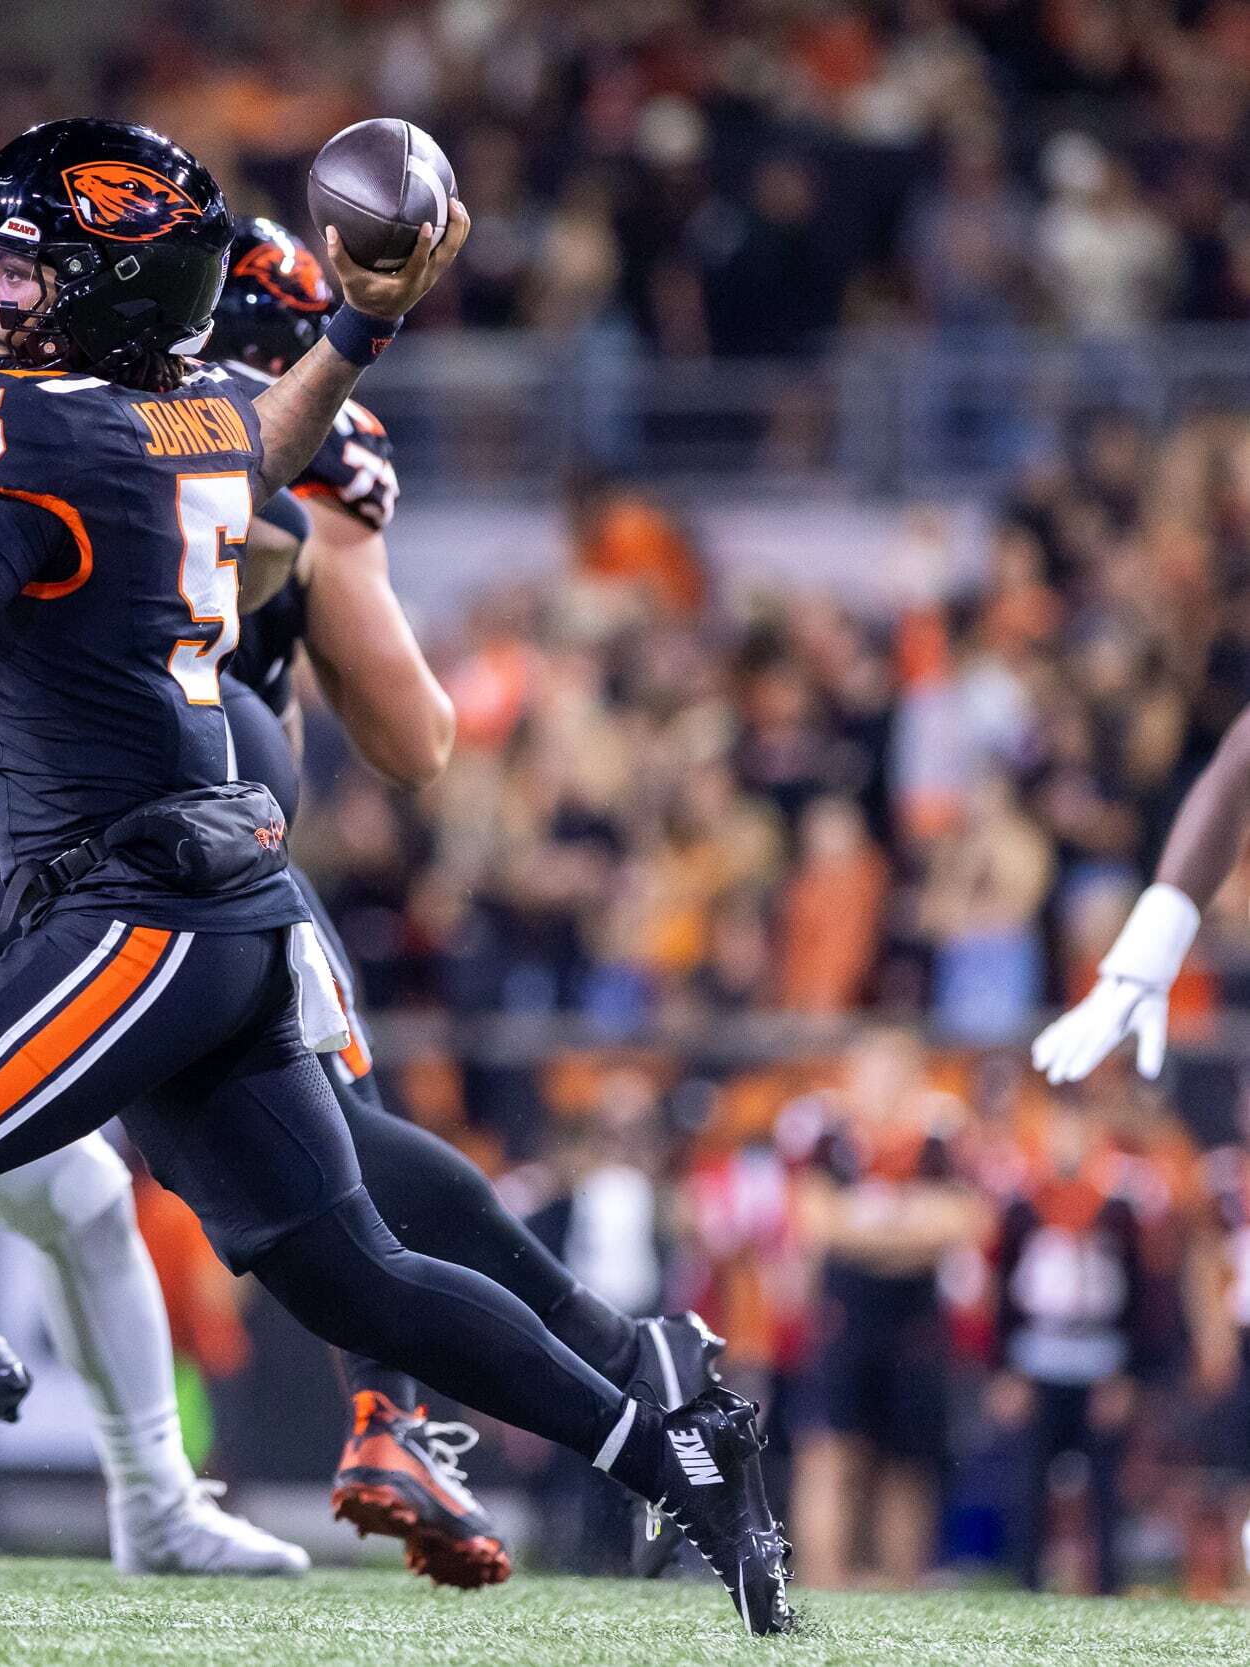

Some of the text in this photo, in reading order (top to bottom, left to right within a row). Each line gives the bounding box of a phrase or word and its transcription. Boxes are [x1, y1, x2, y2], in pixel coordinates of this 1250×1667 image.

[130, 397, 252, 456] JOHNSON
[166, 471, 253, 705] 5
[666, 1427, 725, 1486] NIKE
